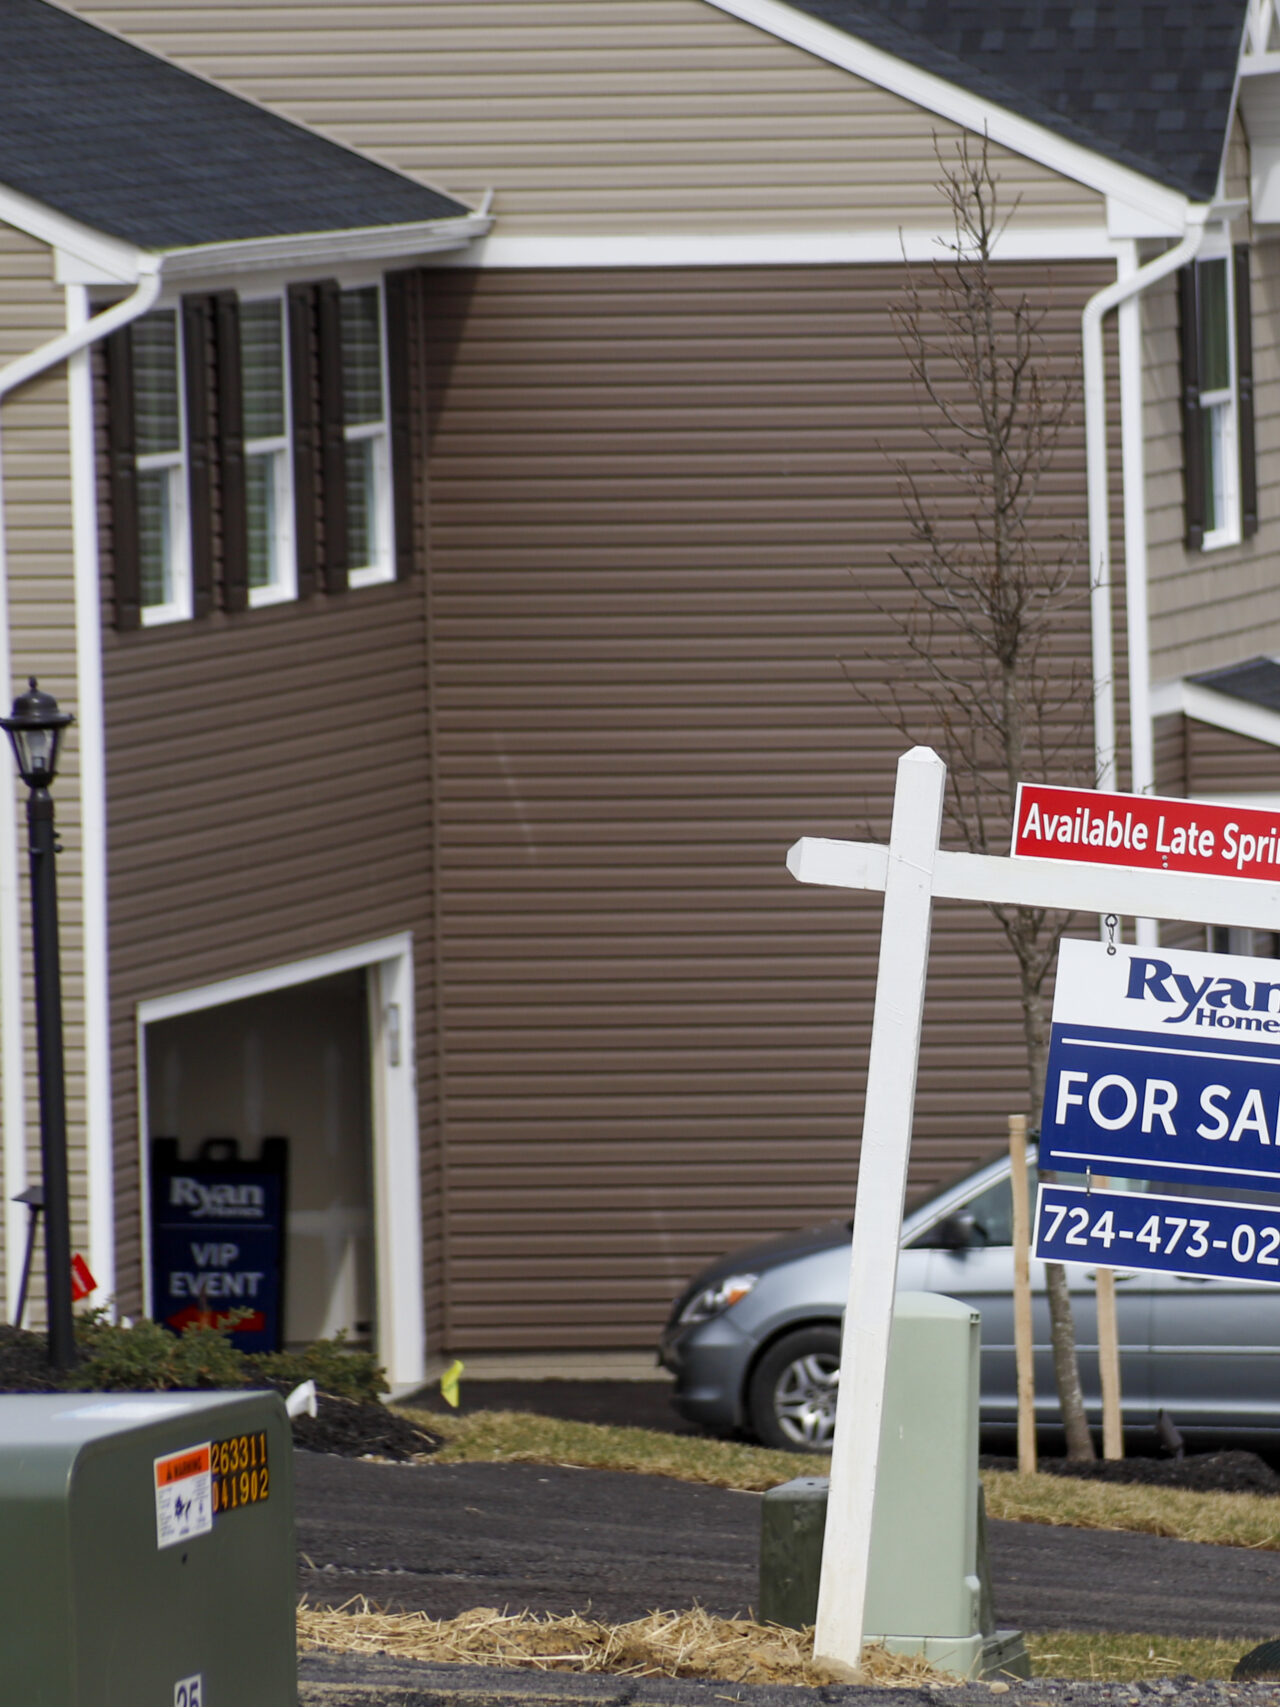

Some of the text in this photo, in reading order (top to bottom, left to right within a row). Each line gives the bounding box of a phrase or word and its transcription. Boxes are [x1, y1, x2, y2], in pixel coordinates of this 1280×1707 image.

[1022, 803, 1148, 850] Available
[1156, 816, 1215, 857] Late
[1055, 1070, 1178, 1136] FOR
[170, 1176, 264, 1217] Ryan
[191, 1242, 239, 1267] VIP
[170, 1272, 264, 1297] EVENT
[211, 1433, 267, 1475] 263311
